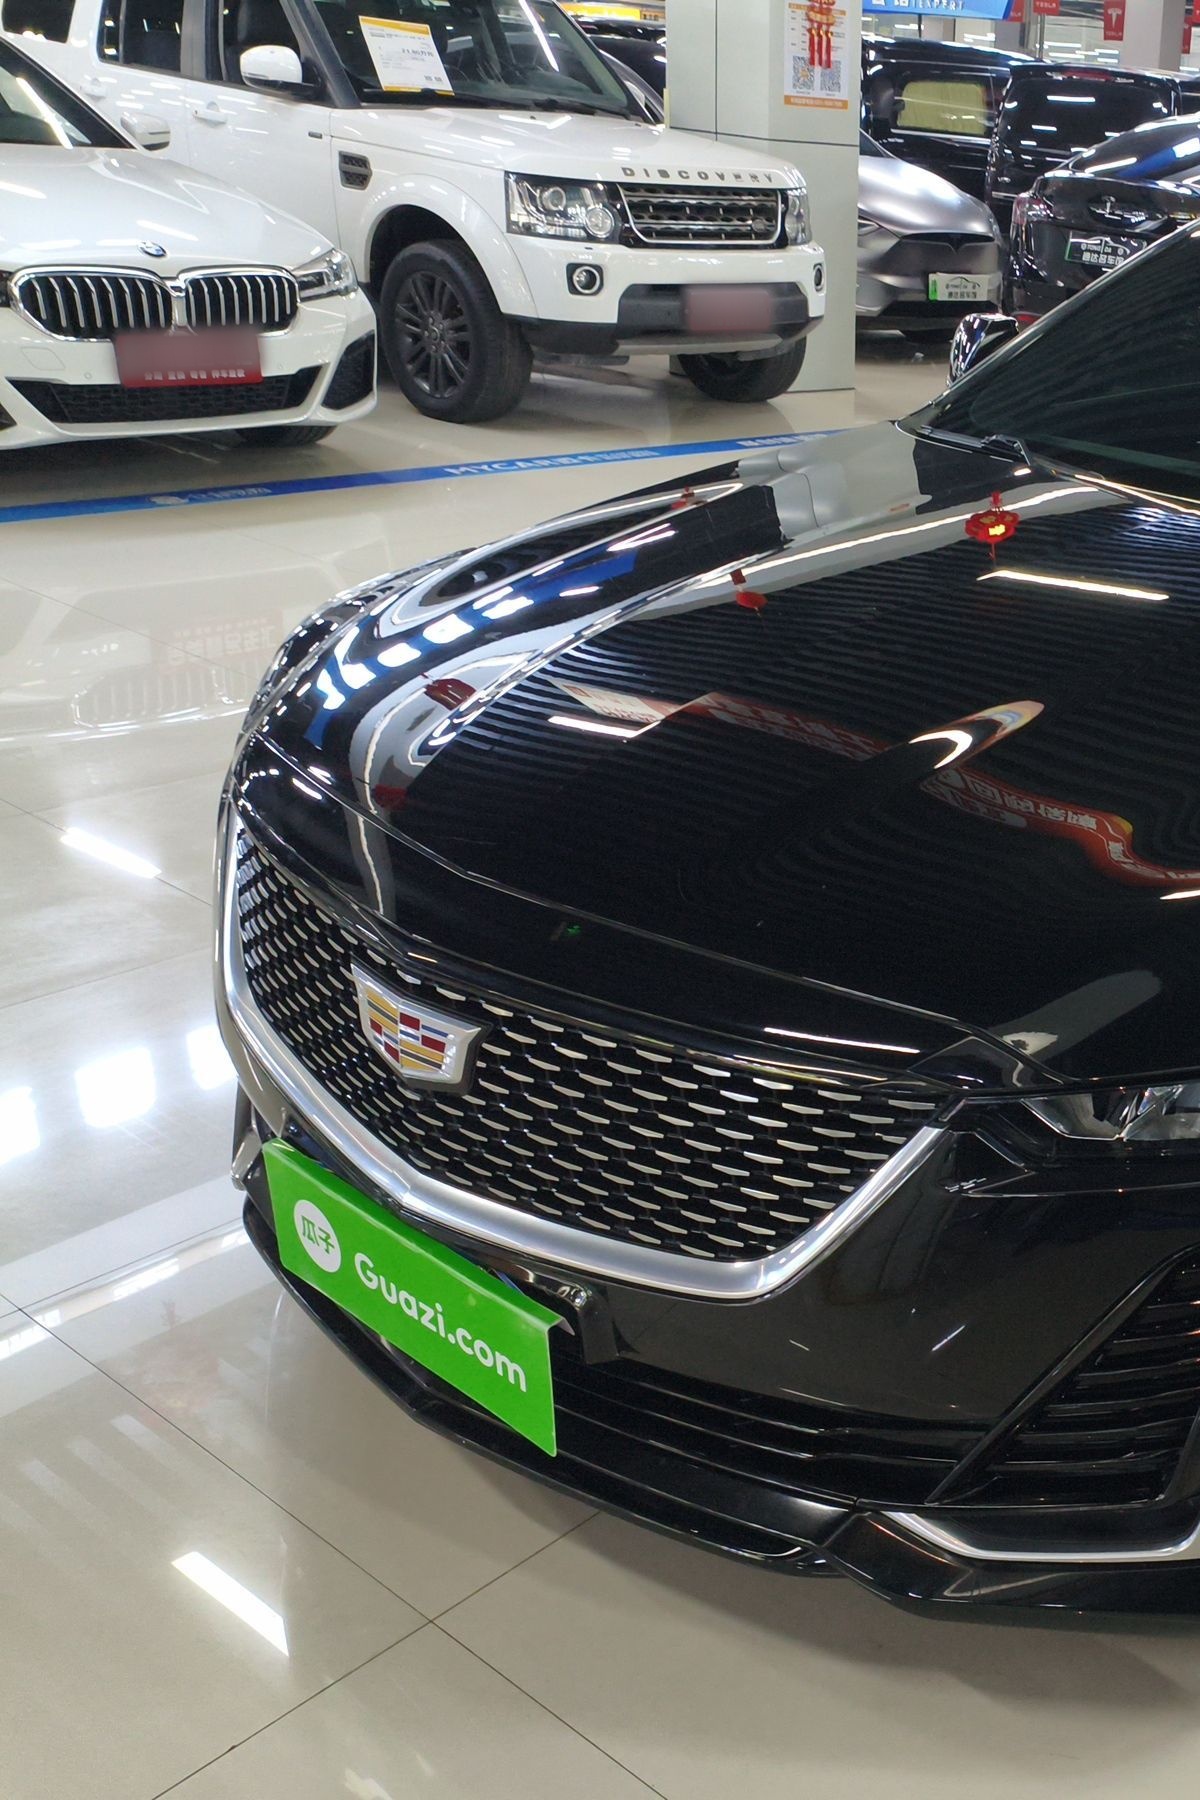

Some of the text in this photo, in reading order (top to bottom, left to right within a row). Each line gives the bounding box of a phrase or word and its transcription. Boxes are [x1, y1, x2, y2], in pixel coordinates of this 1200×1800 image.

[621, 166, 773, 184] DISCOVERY
[301, 1216, 335, 1255] 瓜子
[354, 1252, 527, 1392] Guazi.com
